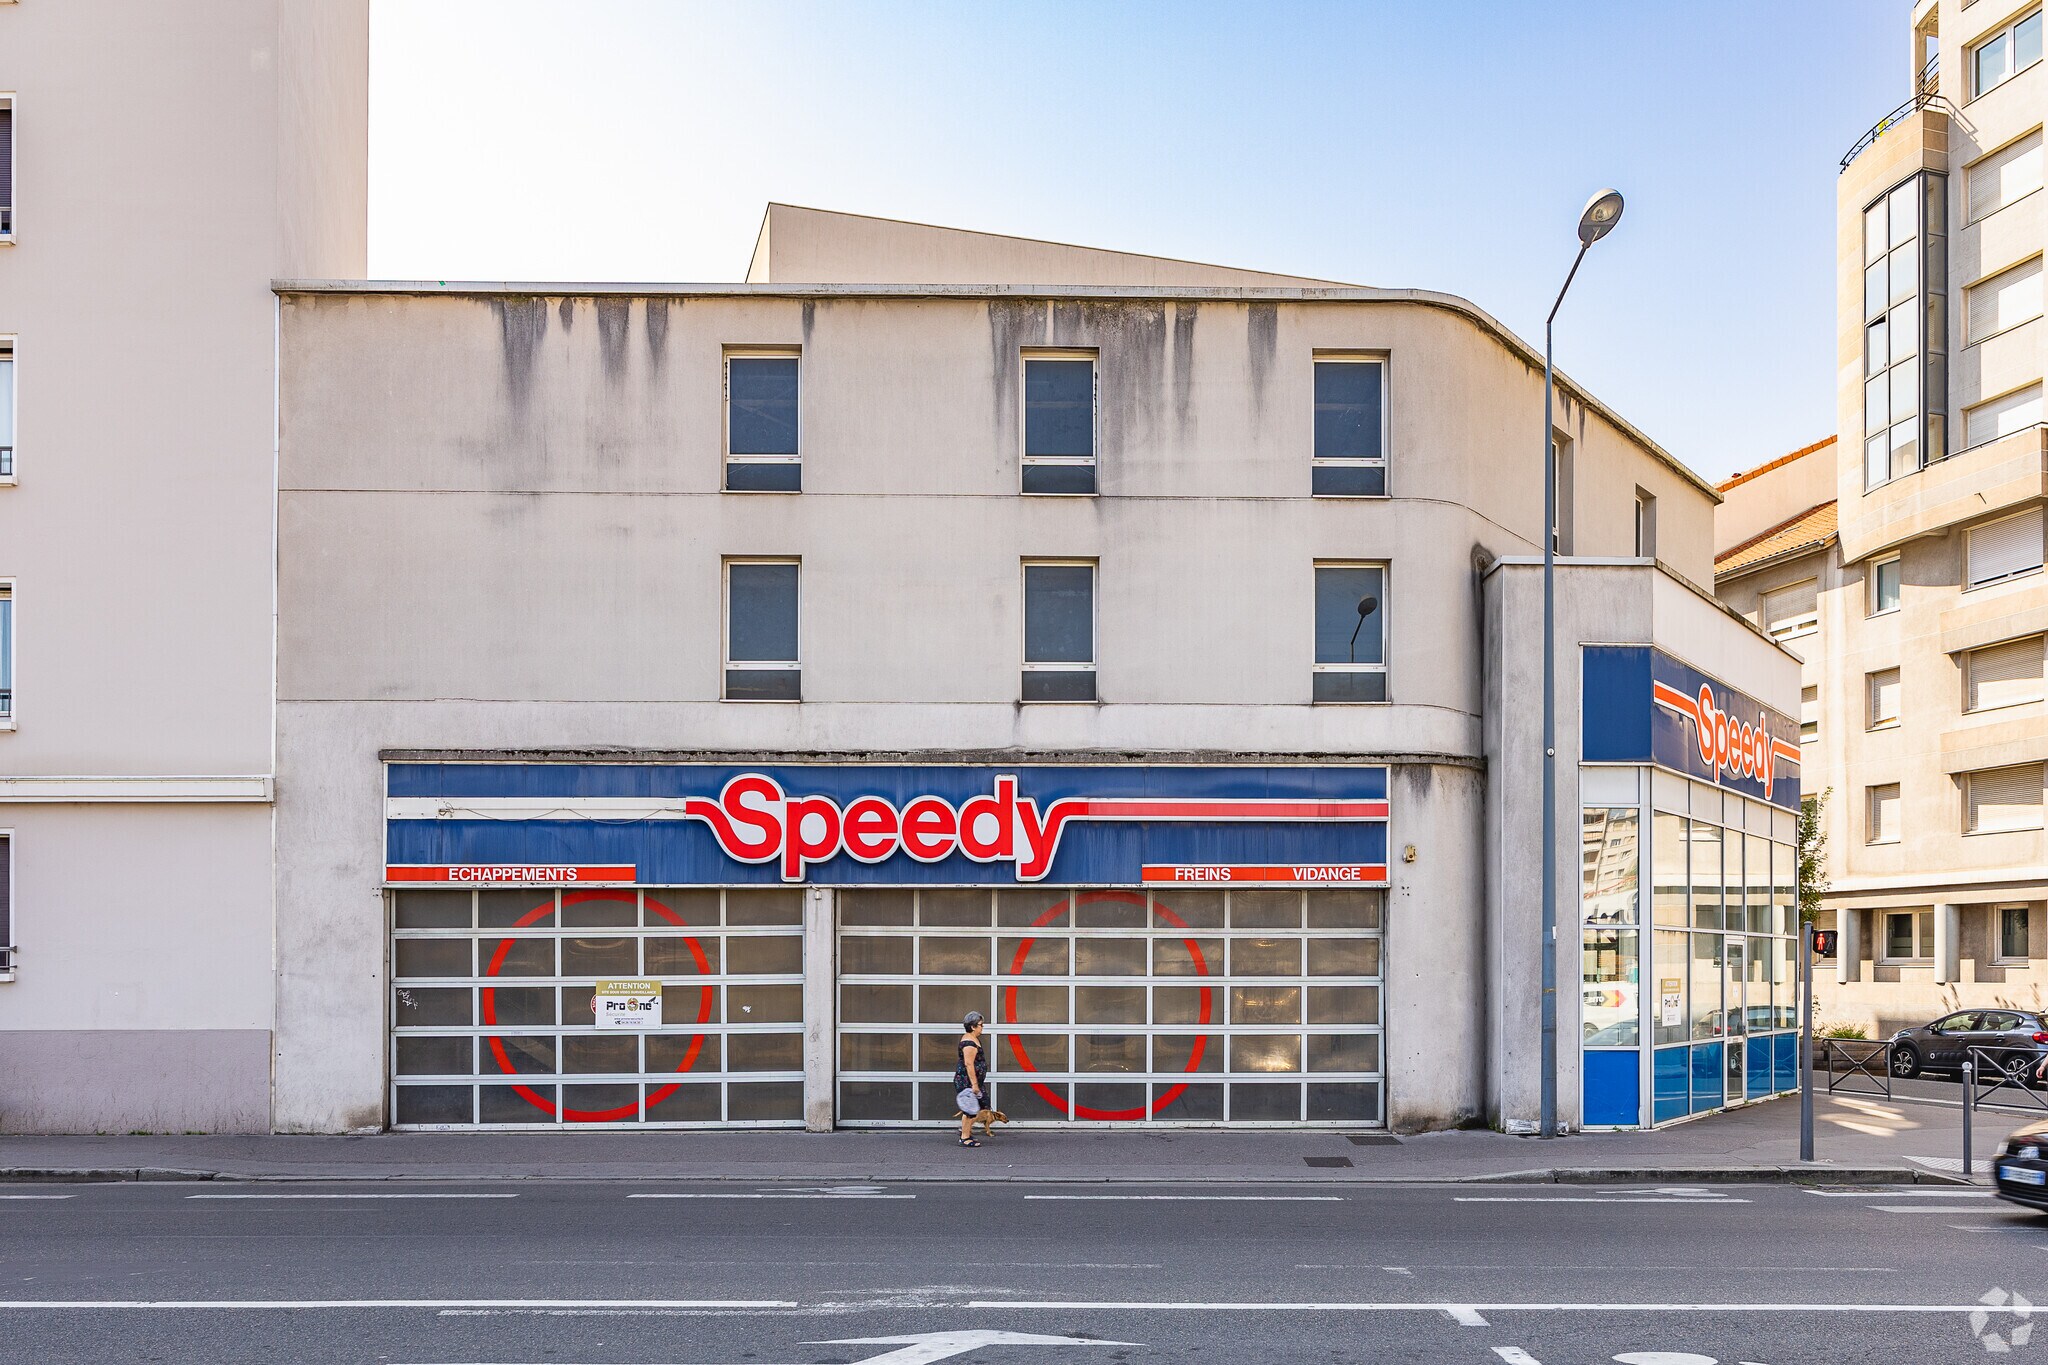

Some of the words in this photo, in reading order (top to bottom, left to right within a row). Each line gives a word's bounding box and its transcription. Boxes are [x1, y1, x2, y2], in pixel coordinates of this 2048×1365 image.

[1694, 682, 1777, 800] Speedy
[686, 774, 1086, 881] Speedy
[448, 866, 578, 882] ECHAPPEMENTS
[1174, 866, 1232, 881] FREINS
[1292, 866, 1362, 881] VIDANGE
